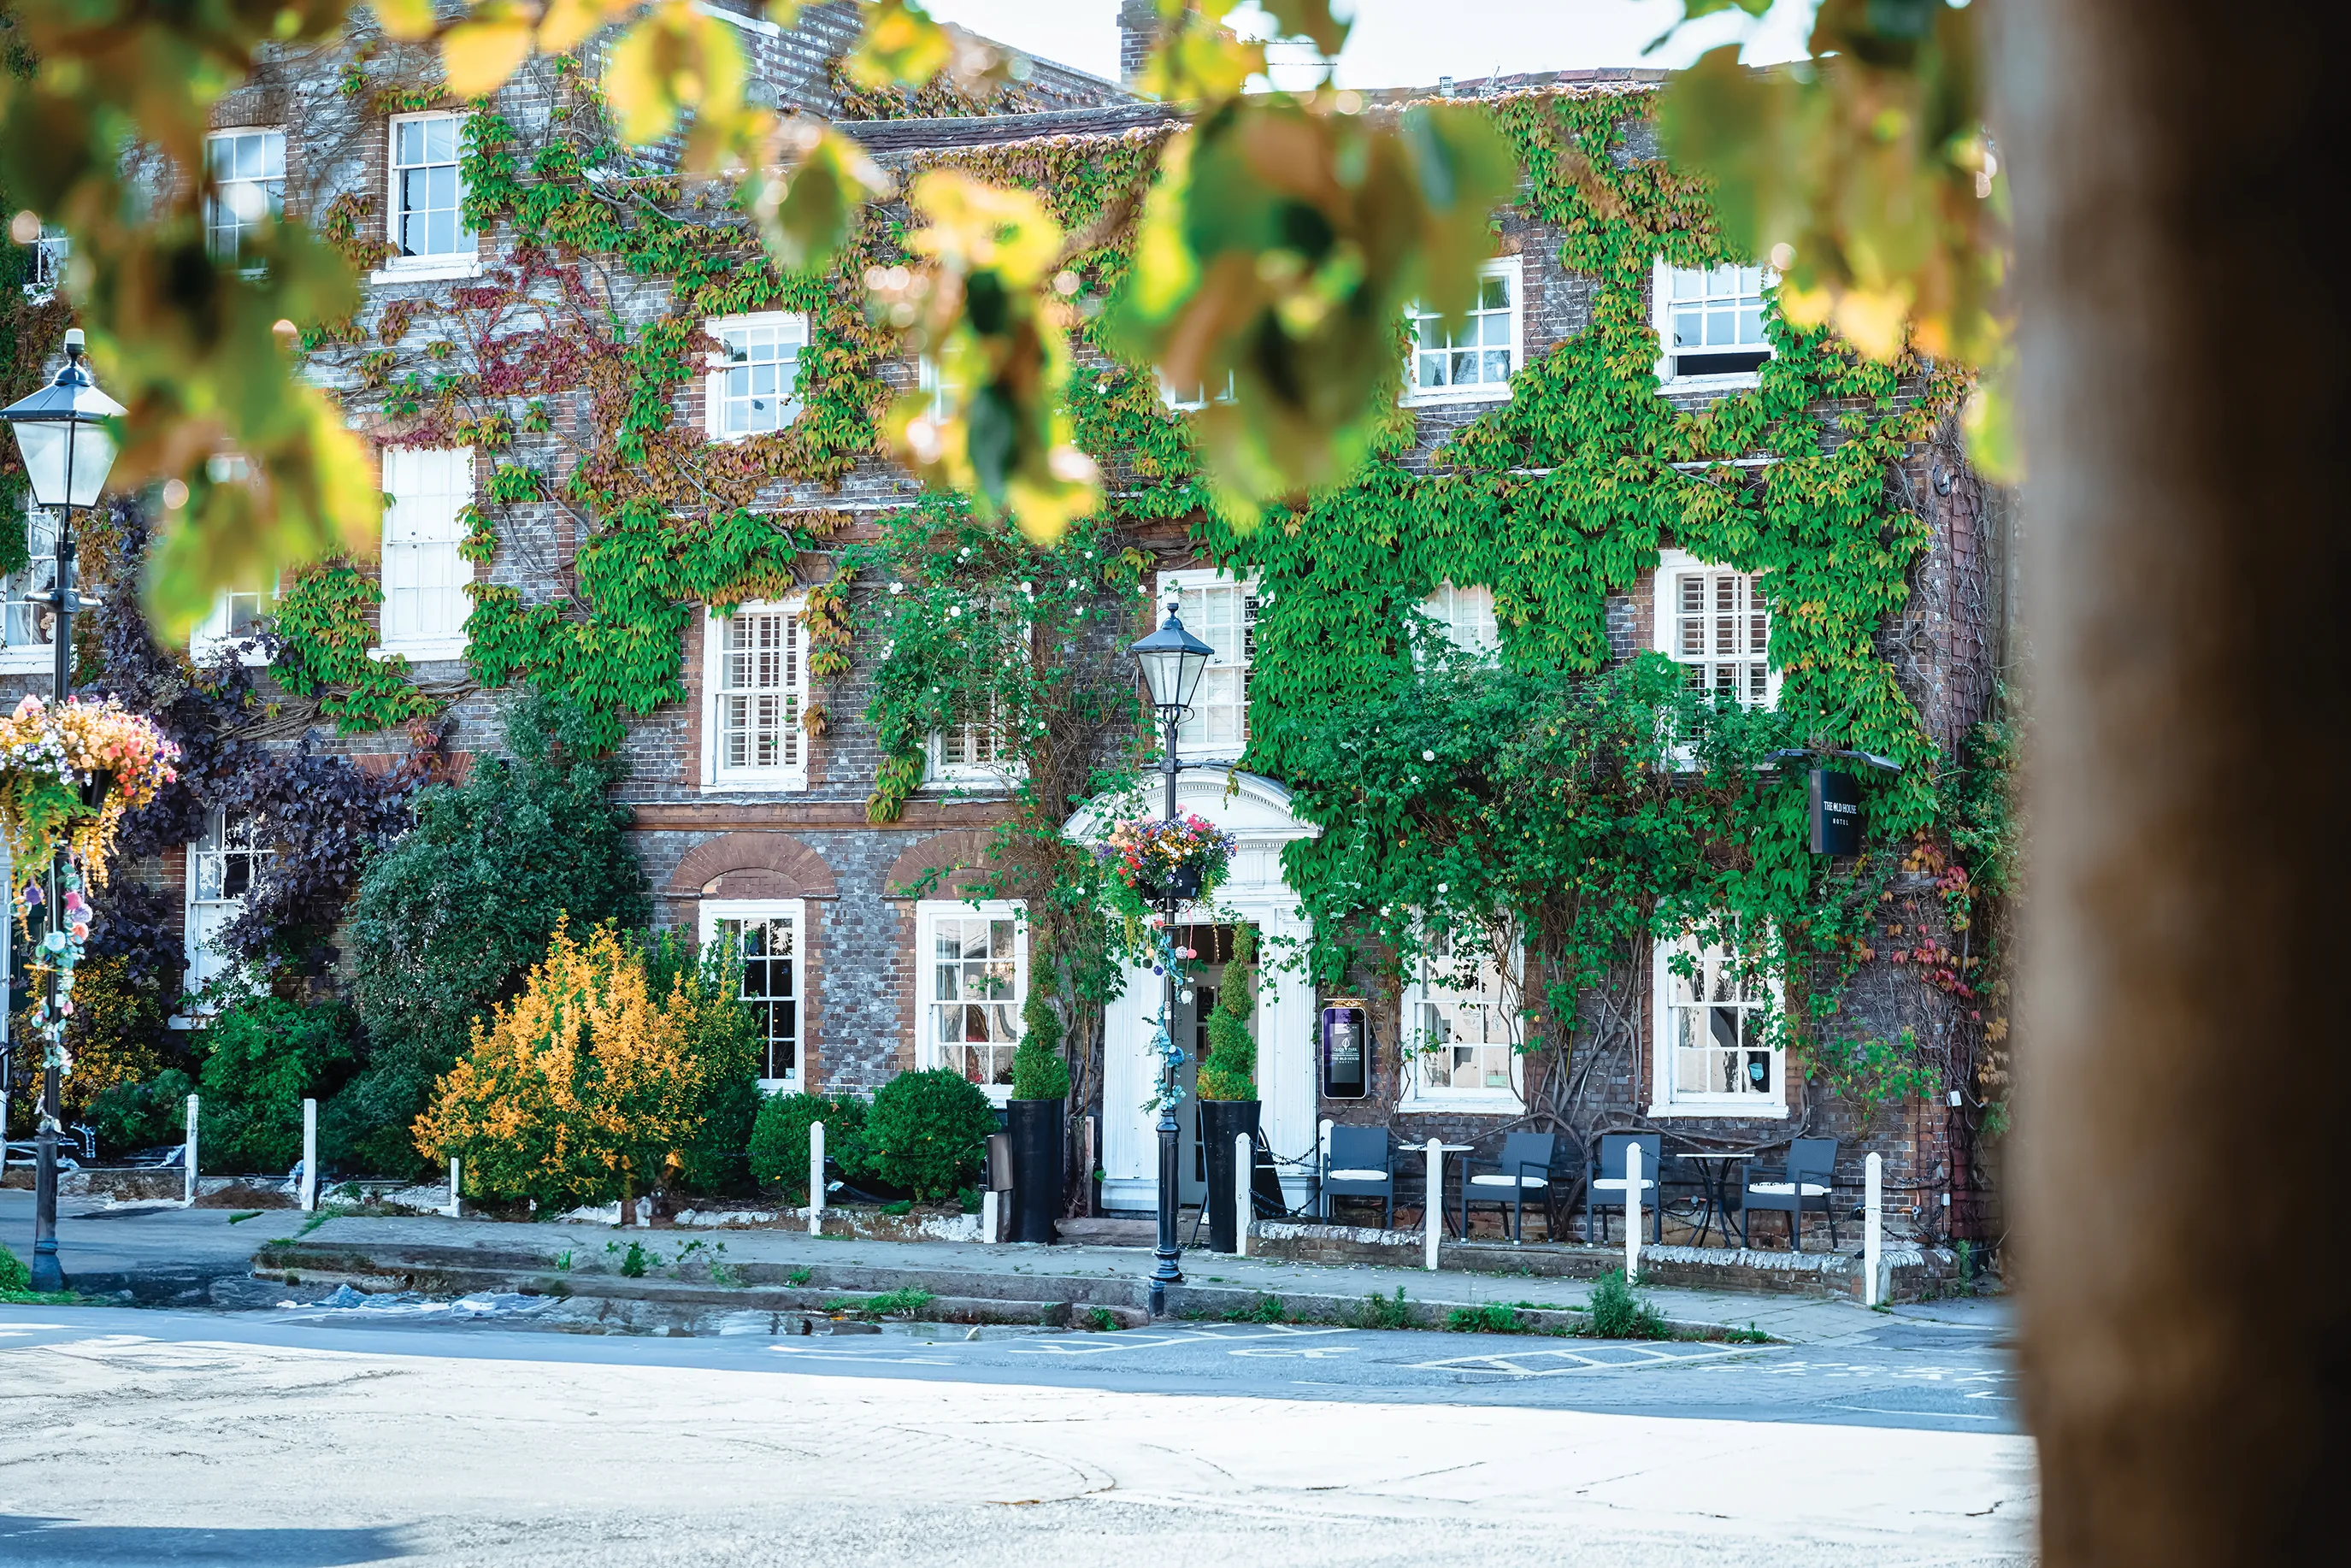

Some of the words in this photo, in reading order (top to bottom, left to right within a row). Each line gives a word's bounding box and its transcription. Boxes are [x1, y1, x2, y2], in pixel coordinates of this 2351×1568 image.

[1824, 801, 1833, 811] THE
[1833, 802, 1842, 812] OLD
[1842, 804, 1857, 815] HOUSE
